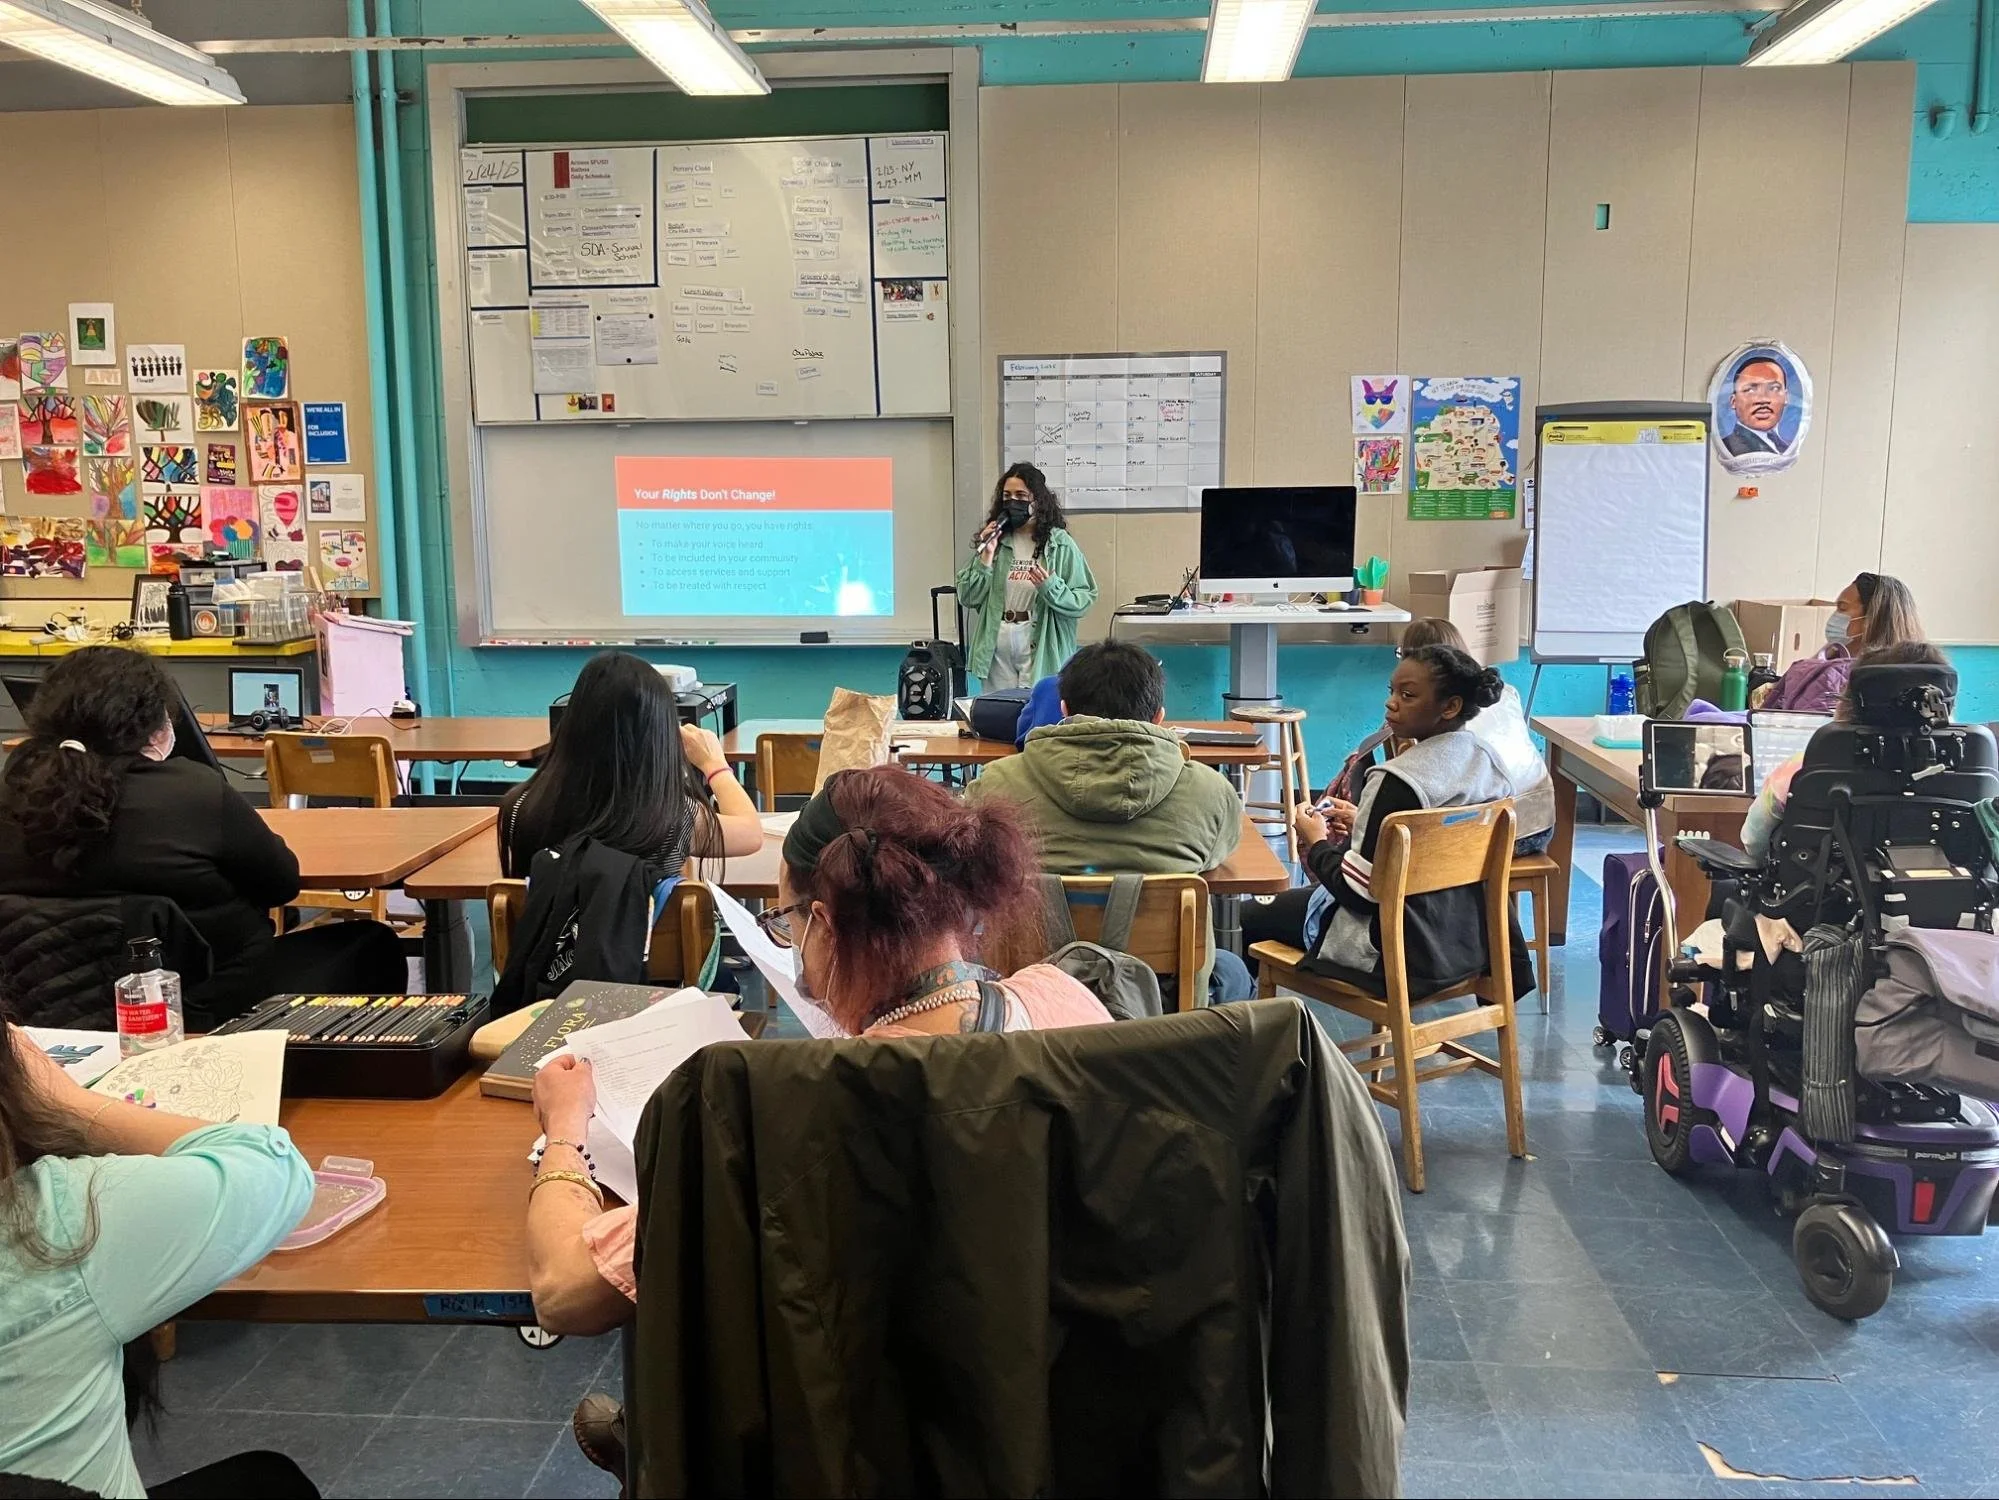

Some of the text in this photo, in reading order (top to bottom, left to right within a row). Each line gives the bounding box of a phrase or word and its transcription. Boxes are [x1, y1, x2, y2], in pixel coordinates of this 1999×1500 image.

[634, 489, 776, 503] Your Rights Don't Change!
[635, 521, 649, 529] No
[651, 521, 681, 529] matter
[683, 521, 710, 529] where
[712, 523, 729, 531] you
[746, 523, 762, 531] you
[763, 521, 786, 530] have
[652, 540, 764, 550] To make your voice heard
[652, 553, 663, 562] To
[665, 554, 677, 562] be
[678, 554, 716, 562] included
[728, 555, 748, 564] your
[749, 554, 799, 564] community
[652, 567, 664, 576] To
[699, 568, 737, 576] services
[739, 568, 755, 576] and
[756, 568, 791, 578] support
[653, 581, 767, 592] To be treated with respect
[543, 1011, 588, 1050] FLORA
